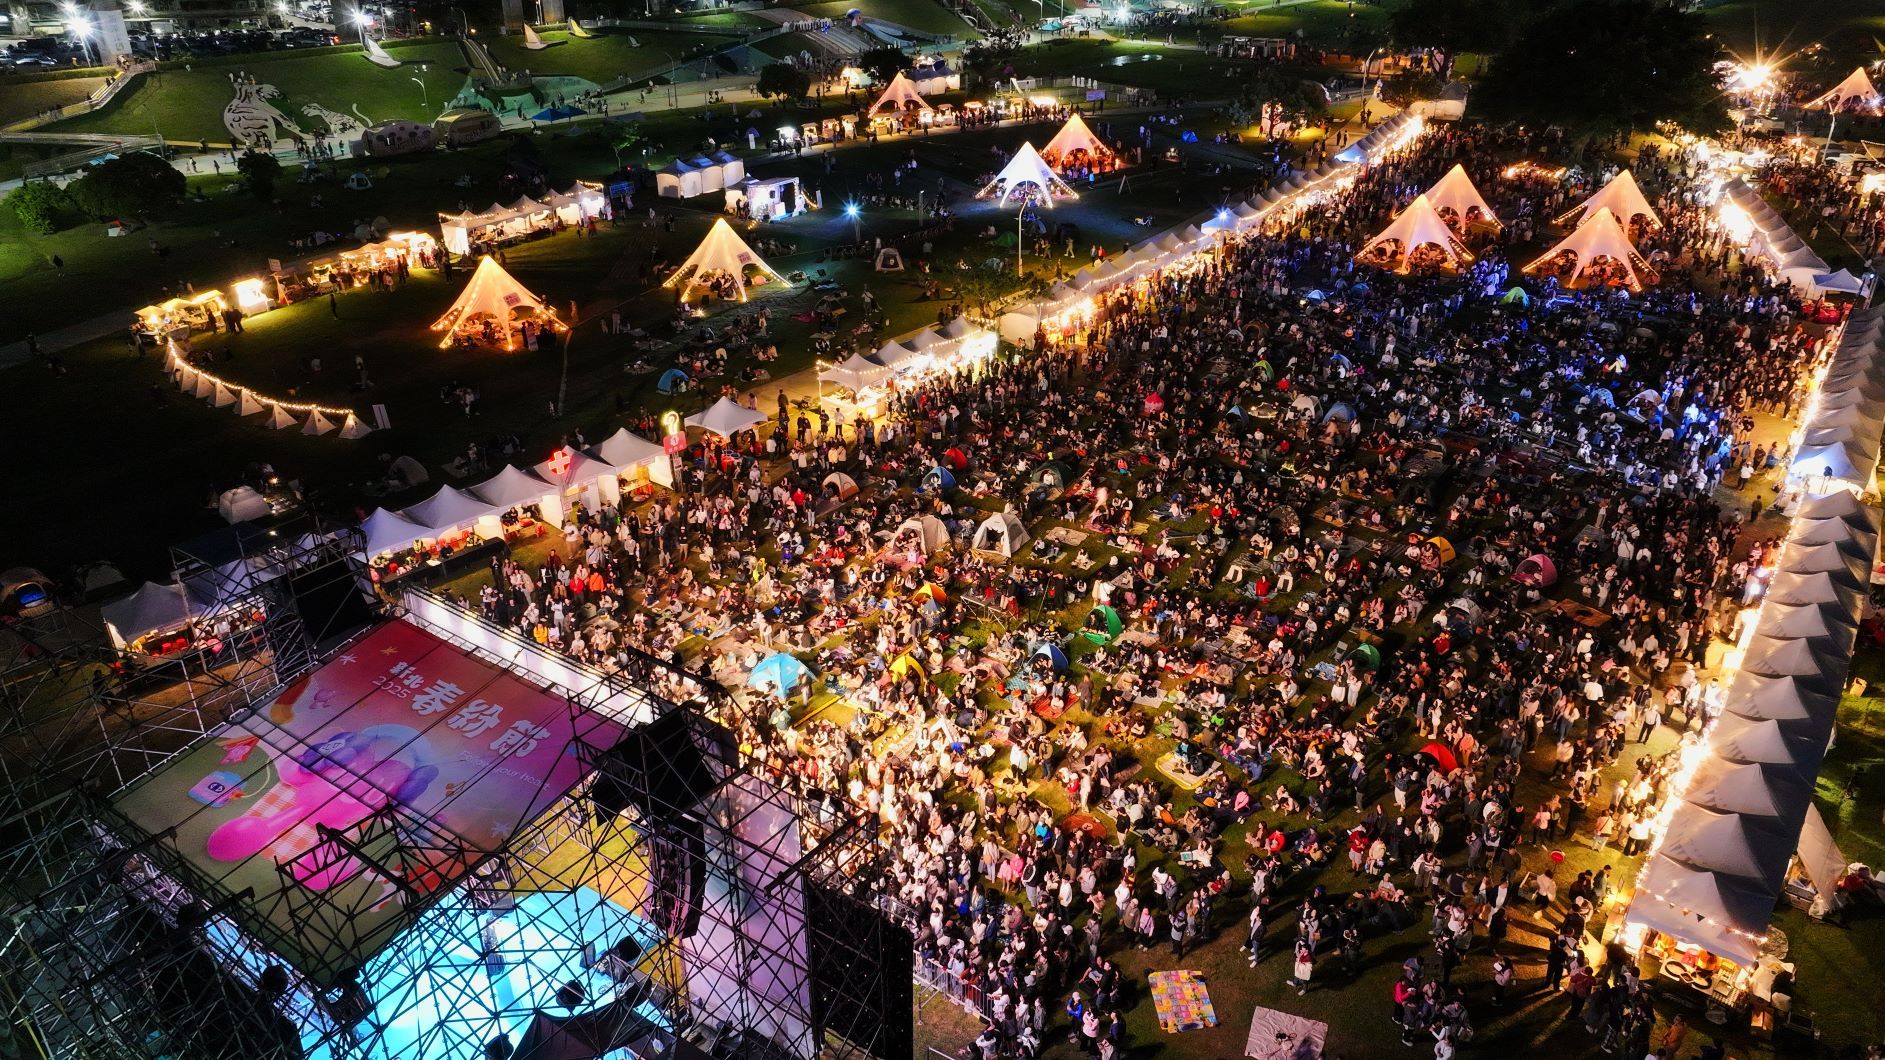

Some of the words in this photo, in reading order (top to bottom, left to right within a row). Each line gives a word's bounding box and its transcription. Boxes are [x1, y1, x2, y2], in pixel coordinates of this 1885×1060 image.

[372, 675, 412, 699] 2025
[389, 661, 425, 689] 新北
[411, 679, 551, 758] 春紛節
